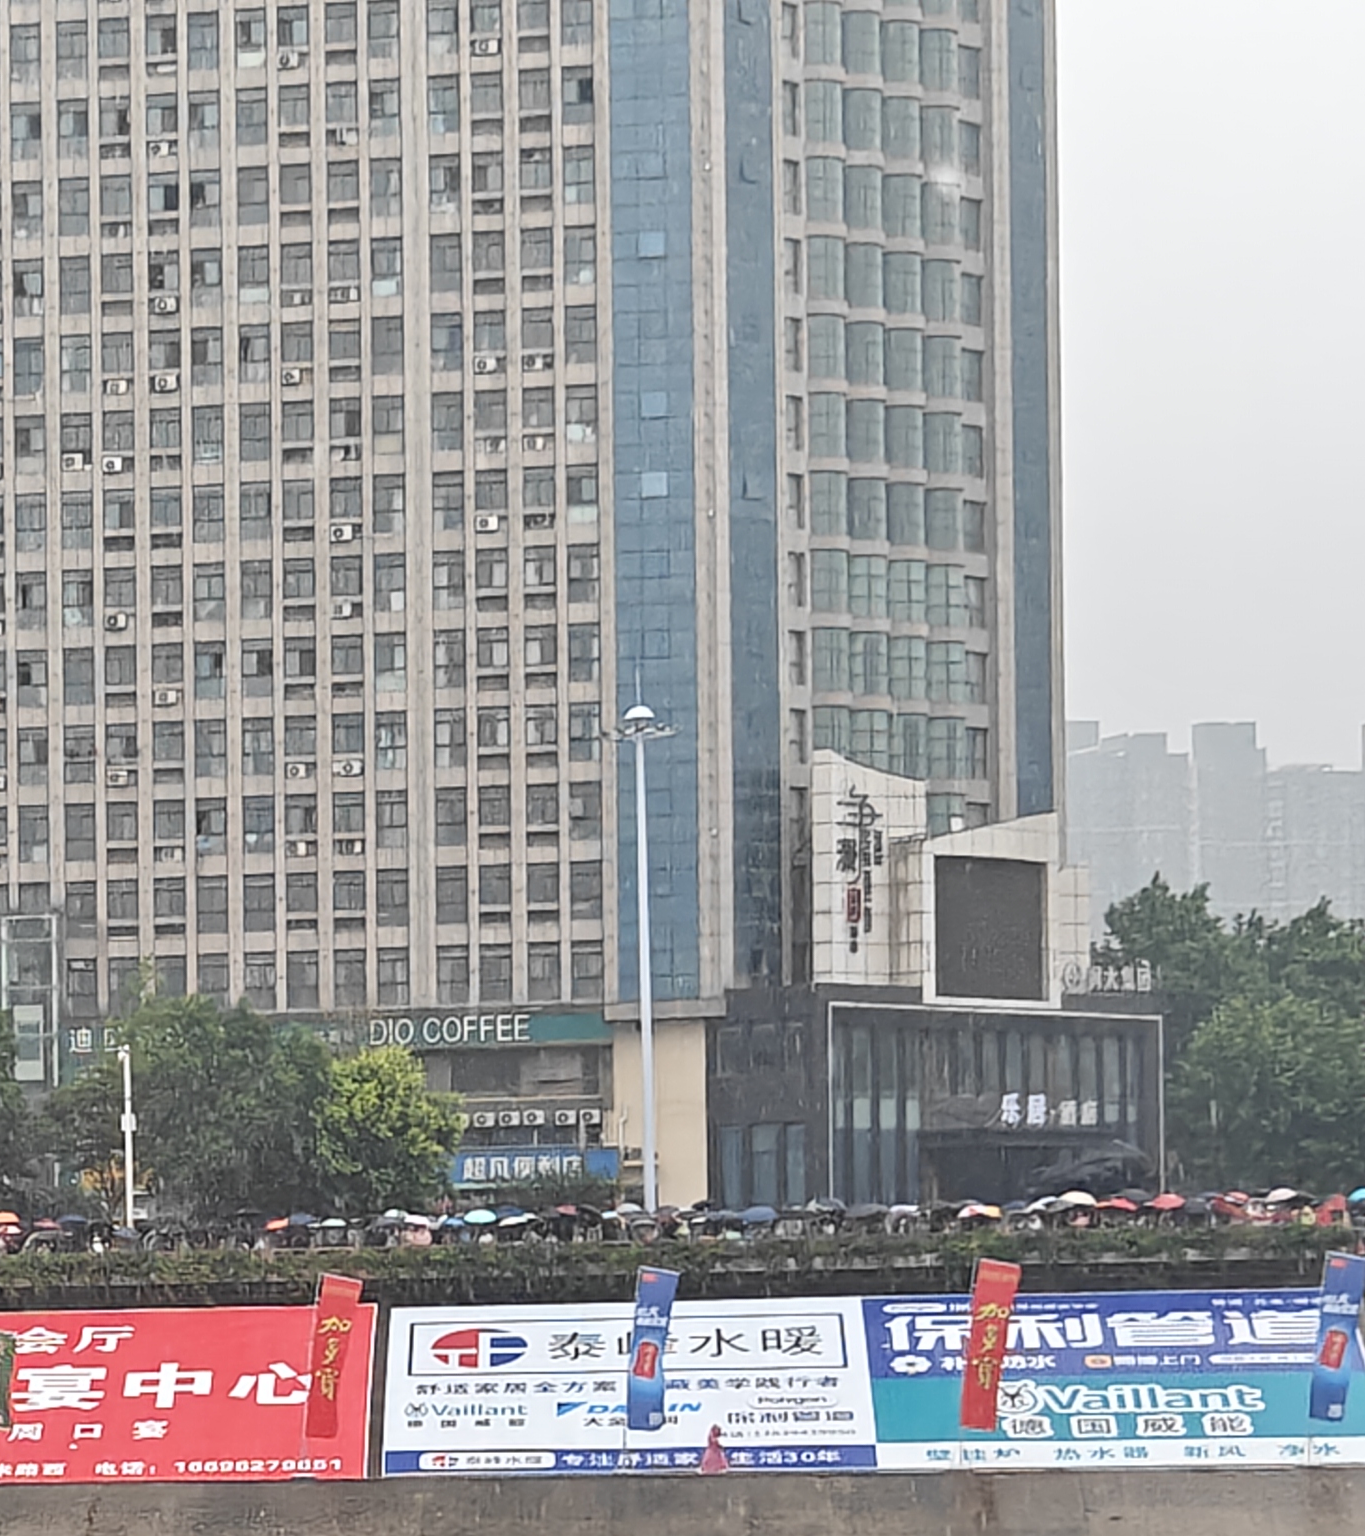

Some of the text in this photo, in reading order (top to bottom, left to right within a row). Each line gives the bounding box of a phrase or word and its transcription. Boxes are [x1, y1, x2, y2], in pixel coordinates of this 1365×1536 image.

[370, 1013, 531, 1046] DIO COFFEE
[881, 1309, 1321, 1350] 保利管道
[586, 1401, 702, 1415] DAIN
[1043, 1384, 1264, 1412] Vaillant
[431, 1402, 529, 1417] Vaillant
[1010, 1416, 1249, 1435] 德国威能
[561, 1450, 842, 1470] 专注舒适家生活30年
